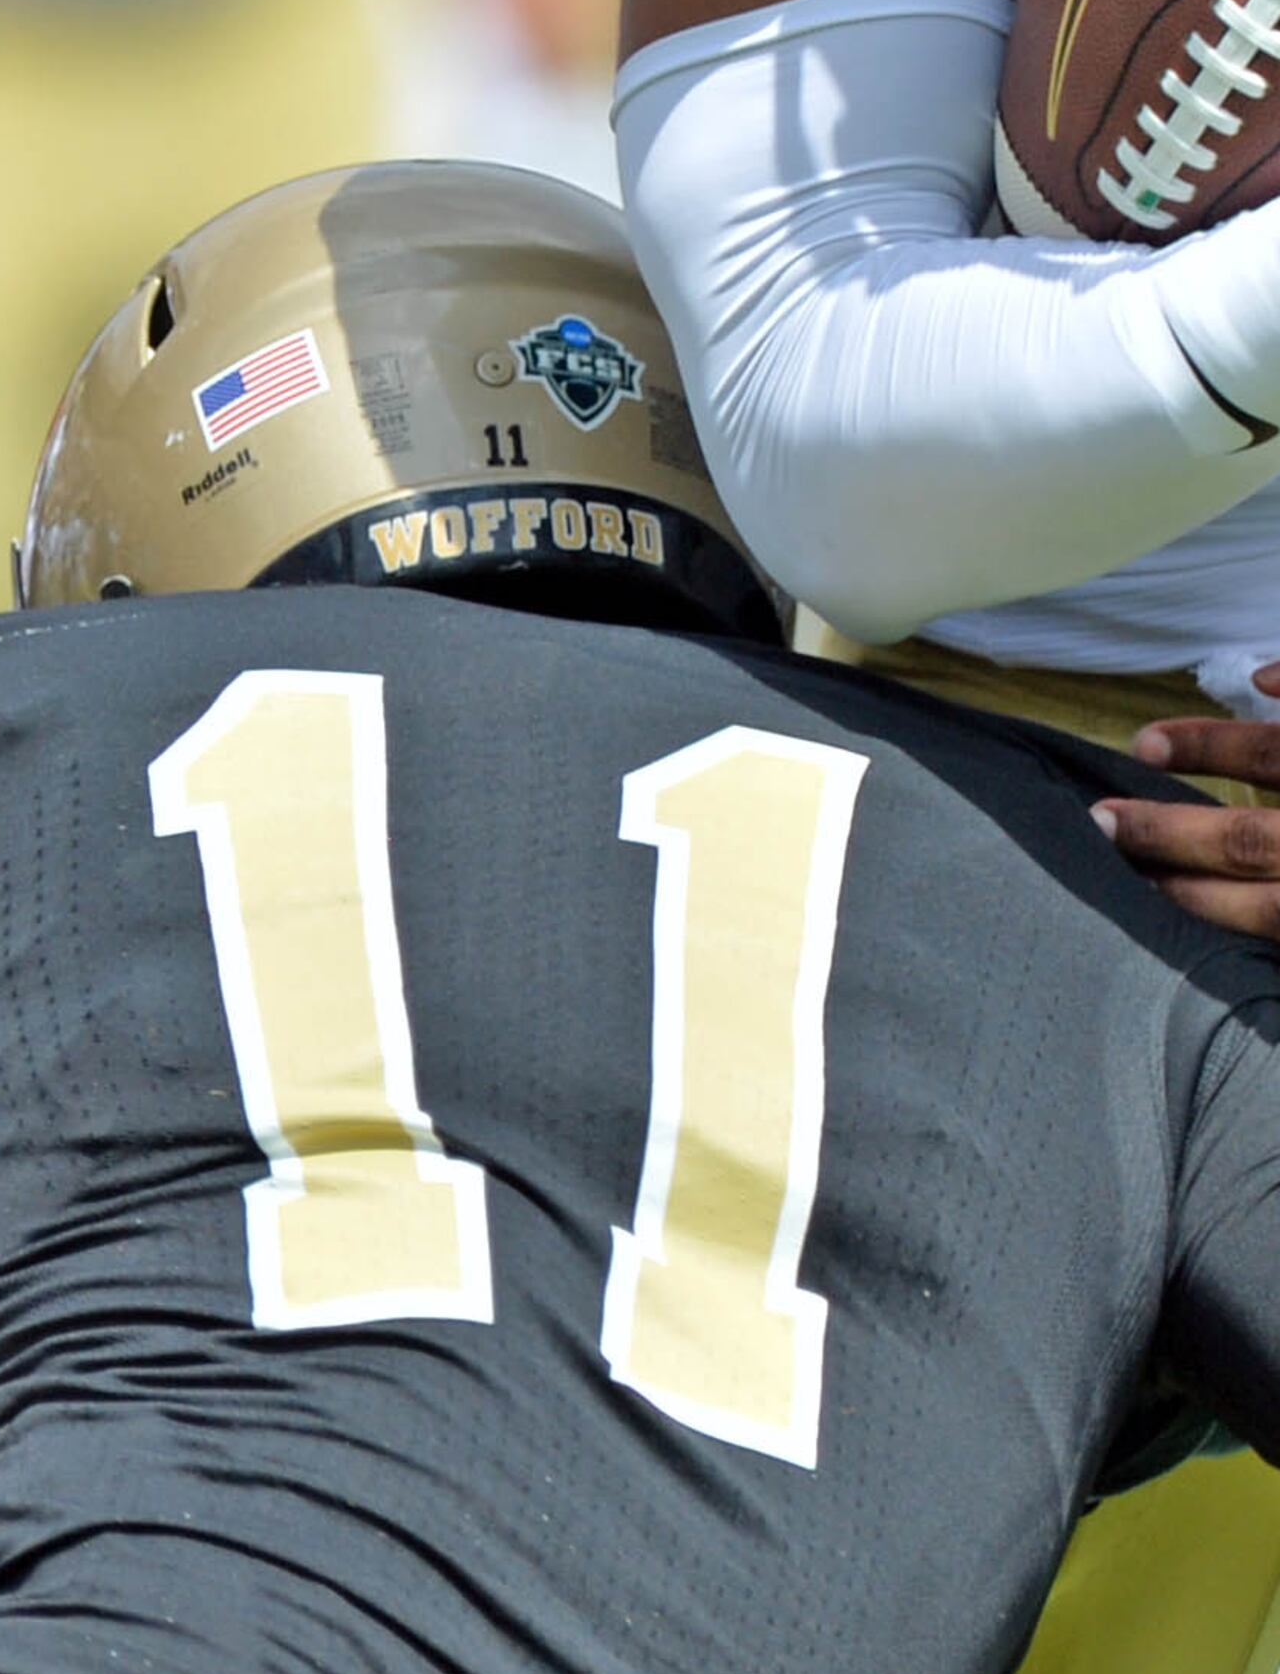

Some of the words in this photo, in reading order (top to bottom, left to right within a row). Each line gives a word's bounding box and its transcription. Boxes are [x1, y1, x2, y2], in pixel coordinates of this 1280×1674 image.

[483, 423, 530, 468] 11
[368, 497, 666, 573] WOFFORD
[147, 668, 871, 1470] 11
